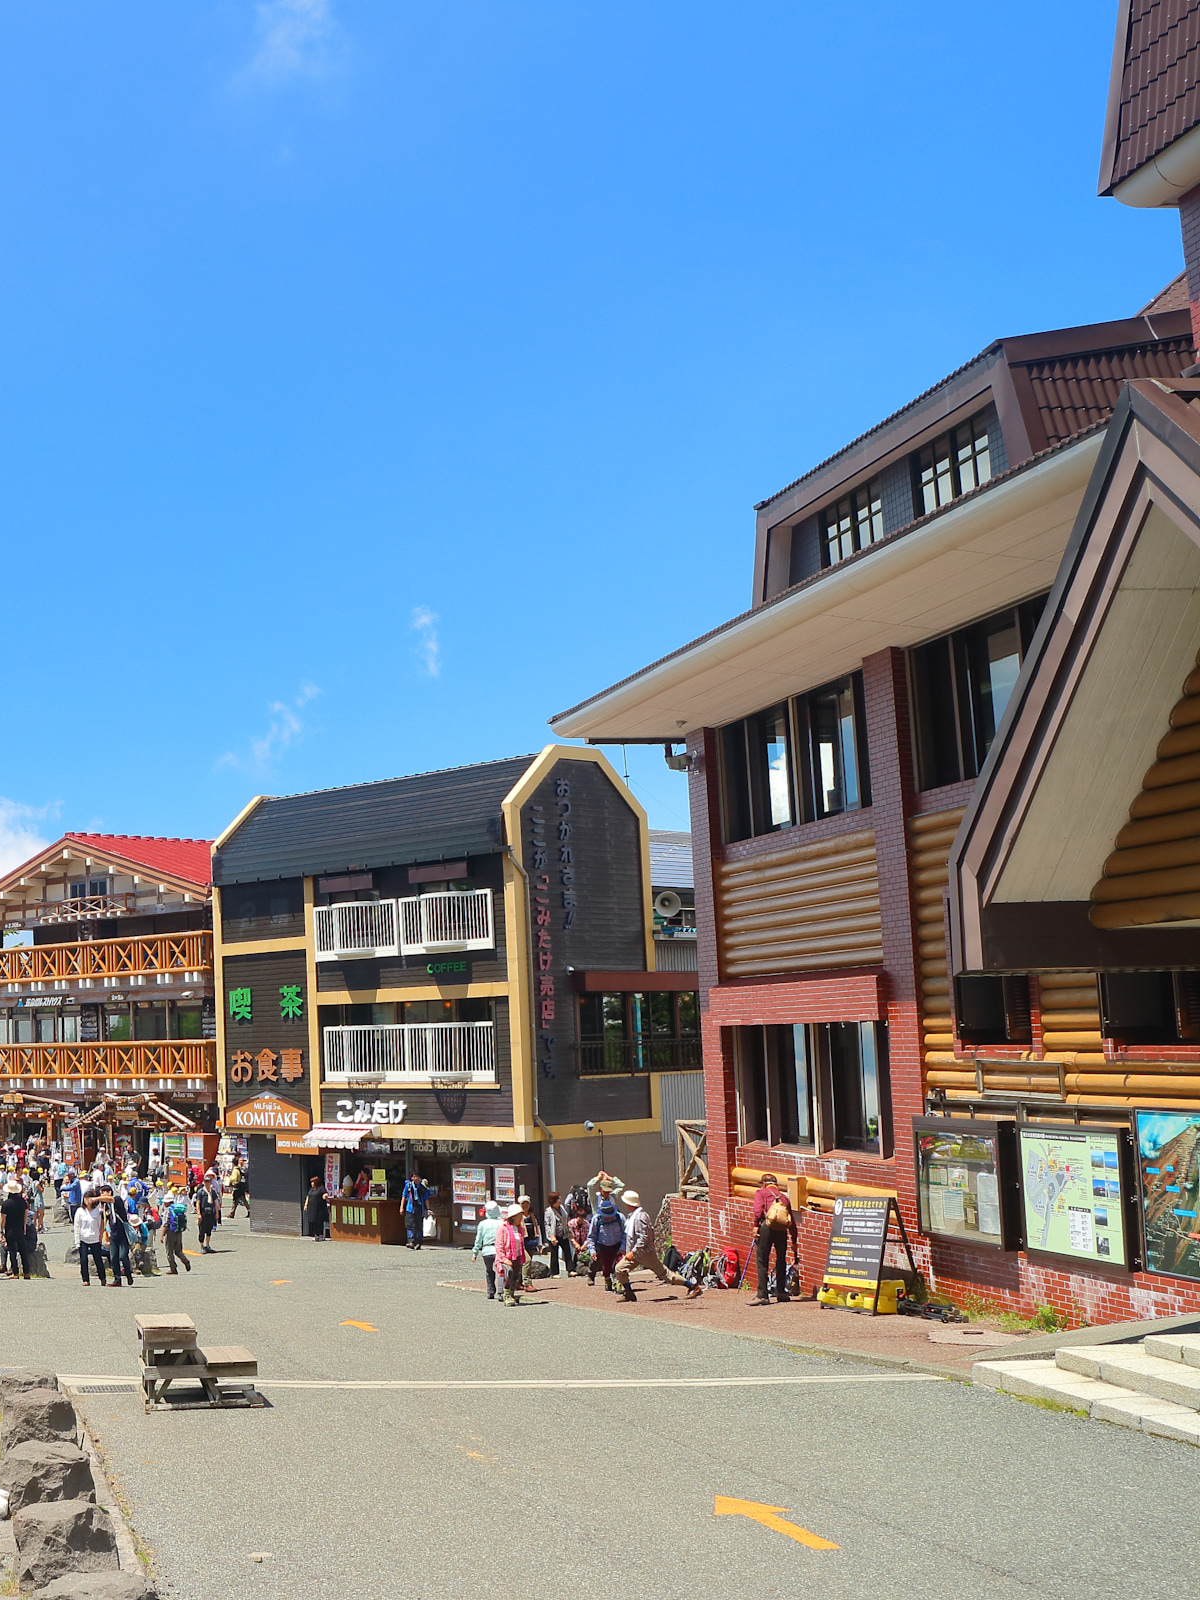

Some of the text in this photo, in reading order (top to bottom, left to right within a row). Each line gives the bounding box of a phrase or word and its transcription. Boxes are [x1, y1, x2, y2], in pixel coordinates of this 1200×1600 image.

[426, 961, 467, 974] COFFEE
[231, 1048, 304, 1083] お食事
[236, 1111, 299, 1127] KOMITAKE
[336, 1099, 407, 1124] こみたけ
[393, 1139, 470, 1154] 記品お渡し所
